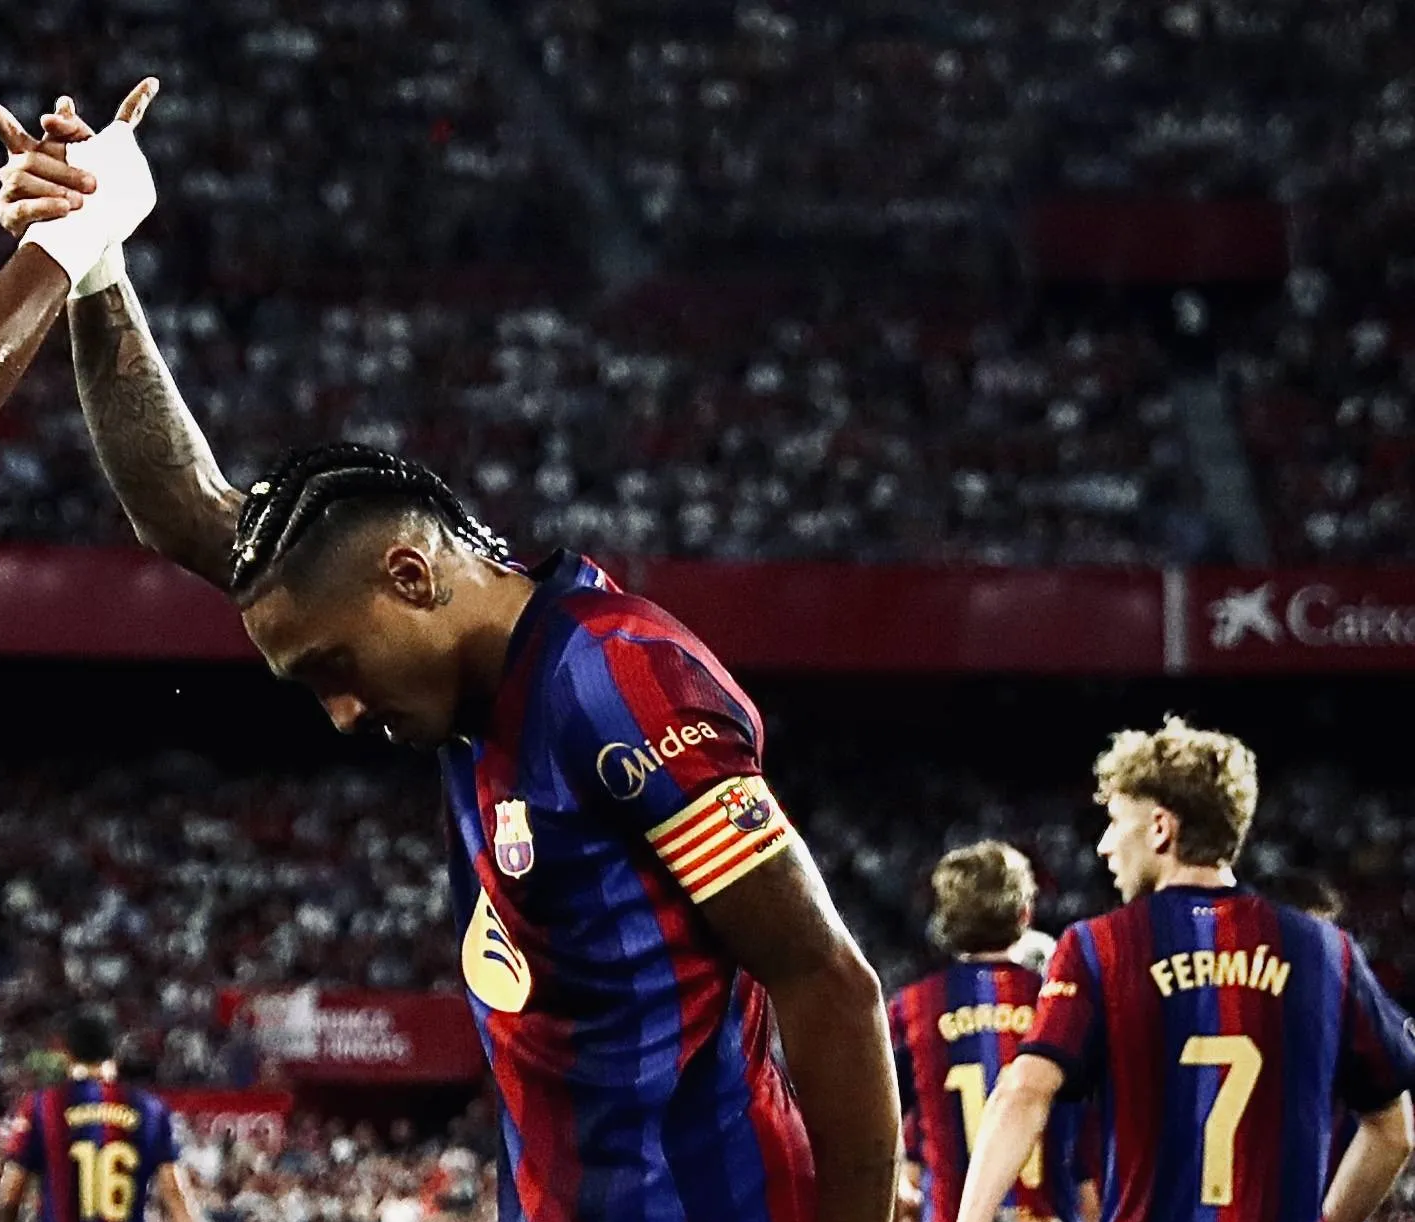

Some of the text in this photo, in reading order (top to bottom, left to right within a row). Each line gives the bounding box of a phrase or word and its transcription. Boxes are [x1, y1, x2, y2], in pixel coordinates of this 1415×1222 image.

[596, 721, 718, 800] Midea
[1150, 945, 1291, 997] FERMÍN
[944, 1063, 1043, 1189] 1
[1179, 1035, 1263, 1206] 7
[68, 1140, 139, 1222] 16
